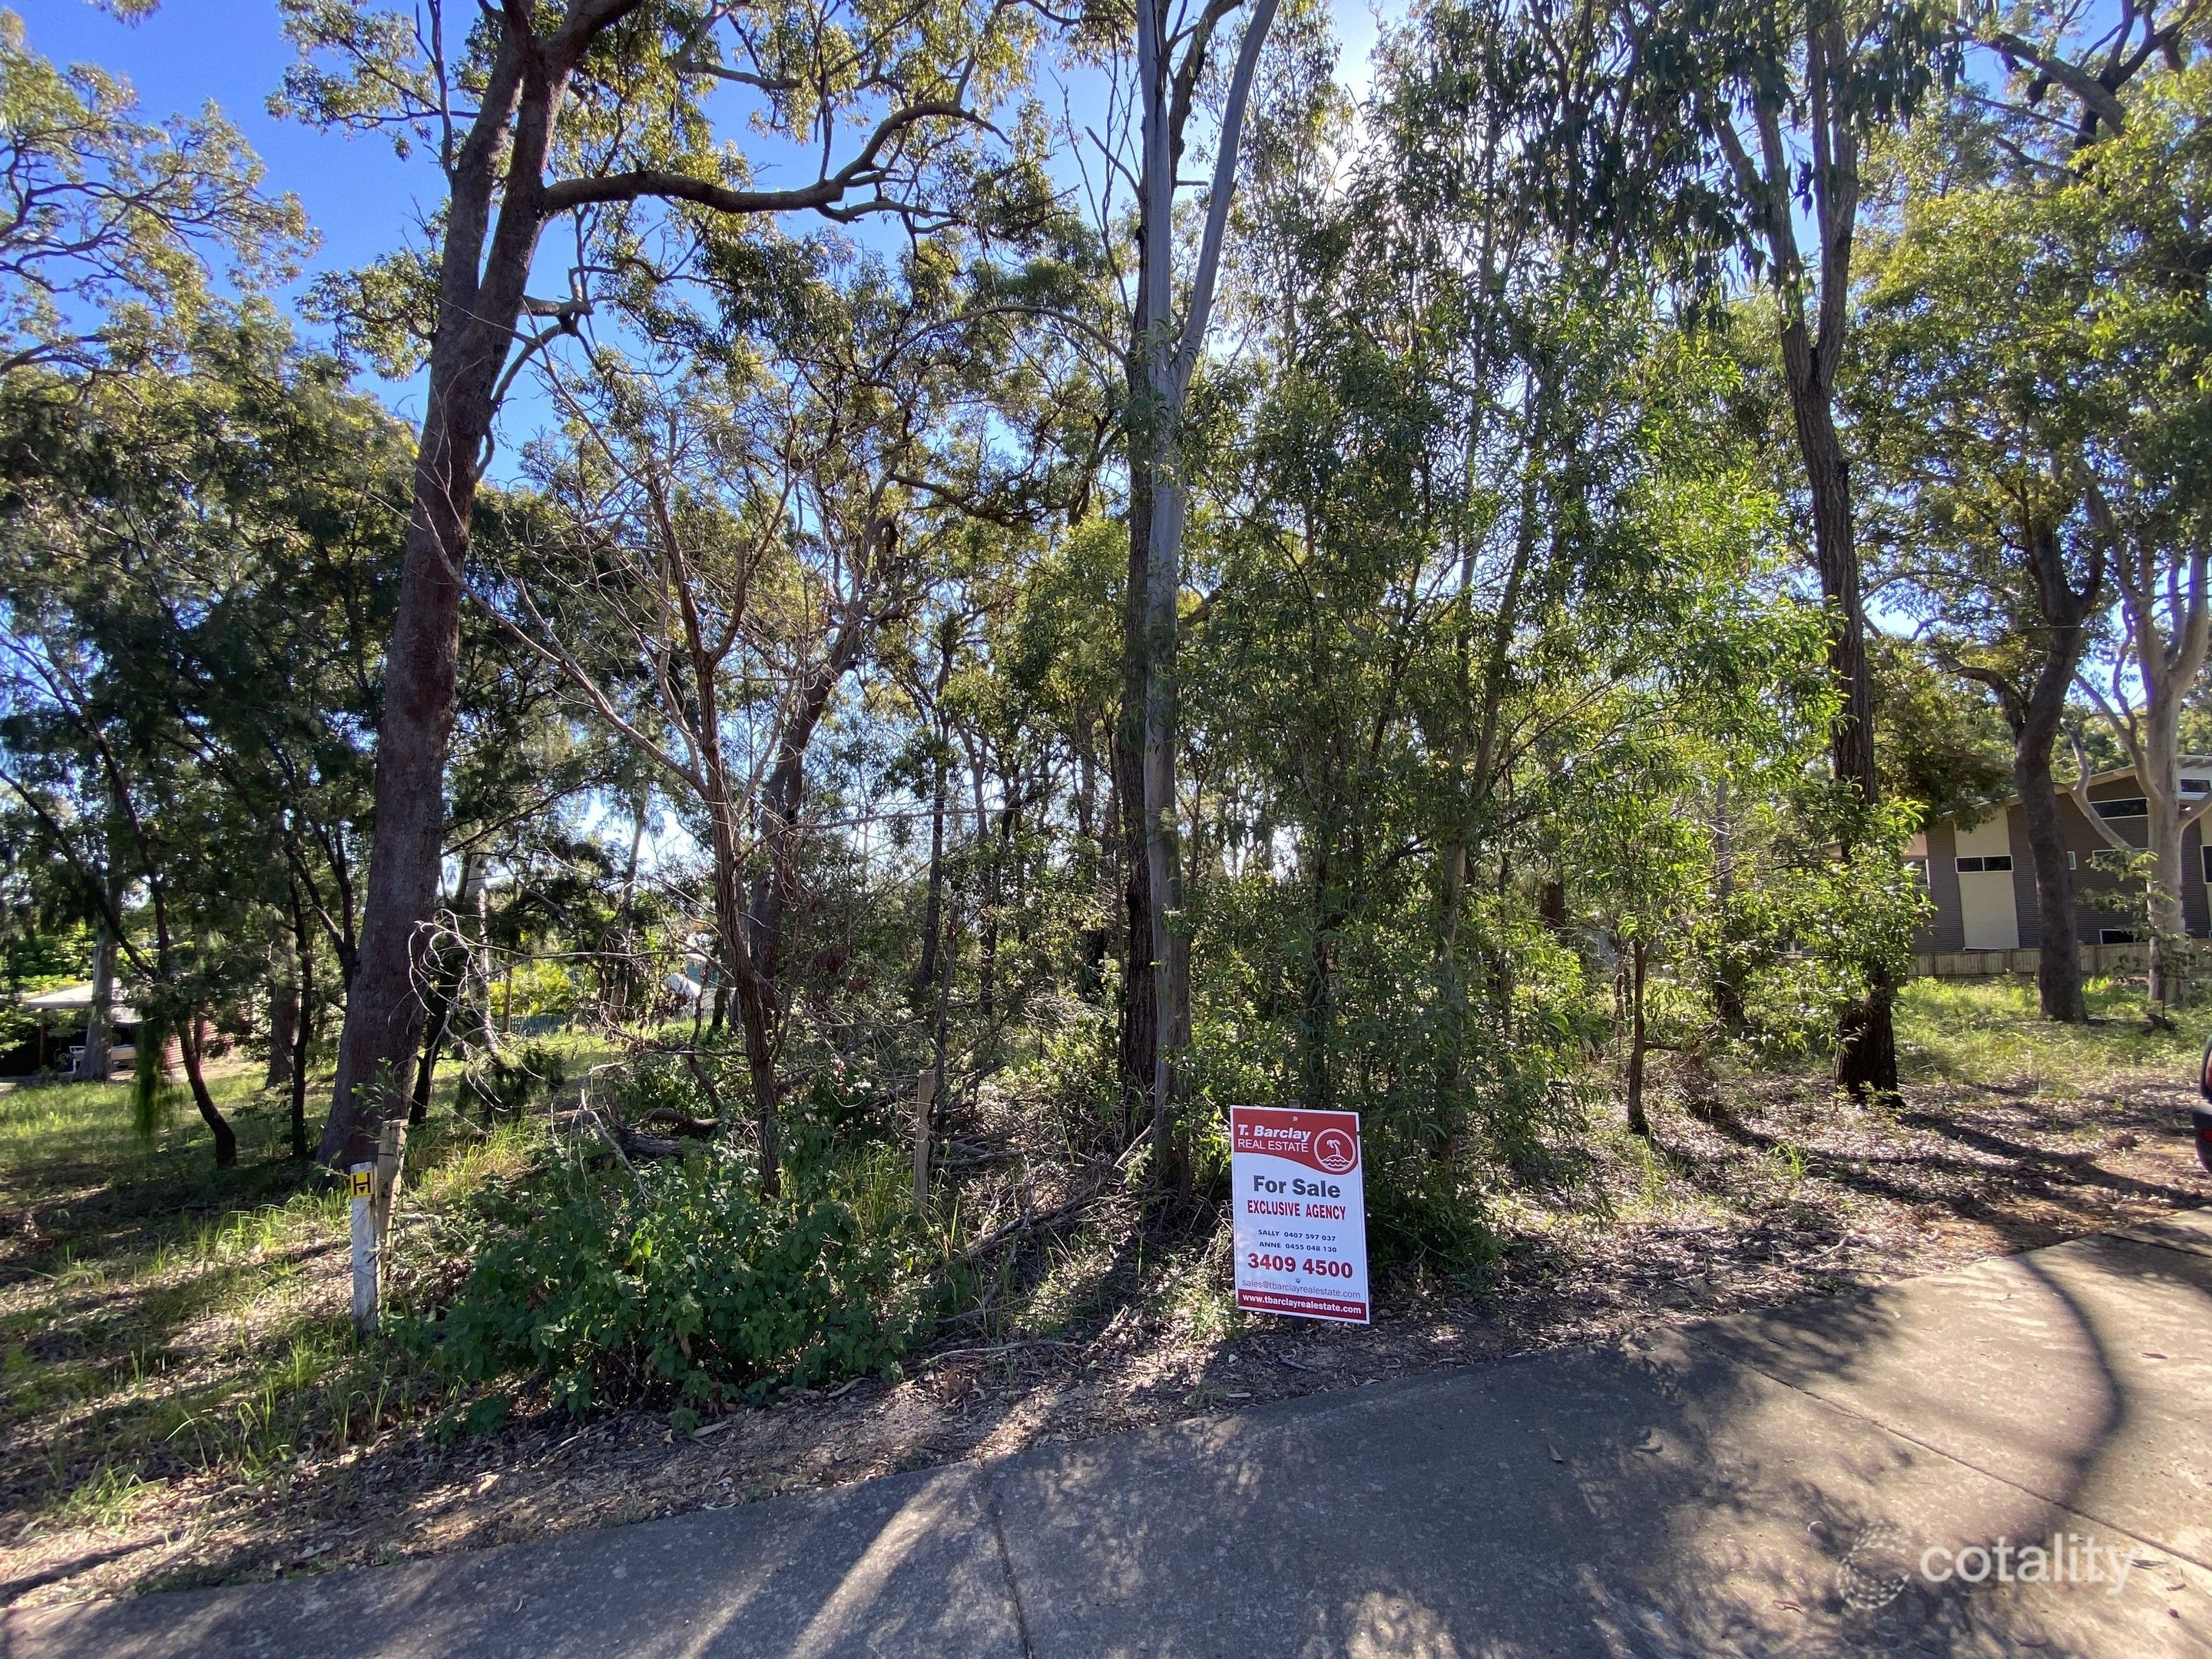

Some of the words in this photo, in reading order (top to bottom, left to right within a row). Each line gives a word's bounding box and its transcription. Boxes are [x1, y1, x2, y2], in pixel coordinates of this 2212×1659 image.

[1238, 1124, 1248, 1136] T.
[1254, 1125, 1311, 1141] Barclay
[1238, 1139, 1265, 1149] REAL
[1269, 1142, 1308, 1152] ESTATE
[353, 1173, 370, 1195] H
[1253, 1175, 1286, 1193] For
[1293, 1178, 1340, 1197] Sale
[1247, 1200, 1300, 1216] EXCLUSIVE
[1306, 1204, 1346, 1220] AGENCY
[1248, 1253, 1296, 1272] 3409
[1303, 1259, 1353, 1278] 4500
[1242, 1279, 1360, 1299] sales@tbarclayrealestate.com
[1243, 1293, 1361, 1314] www.tbarclayrealestate.com
